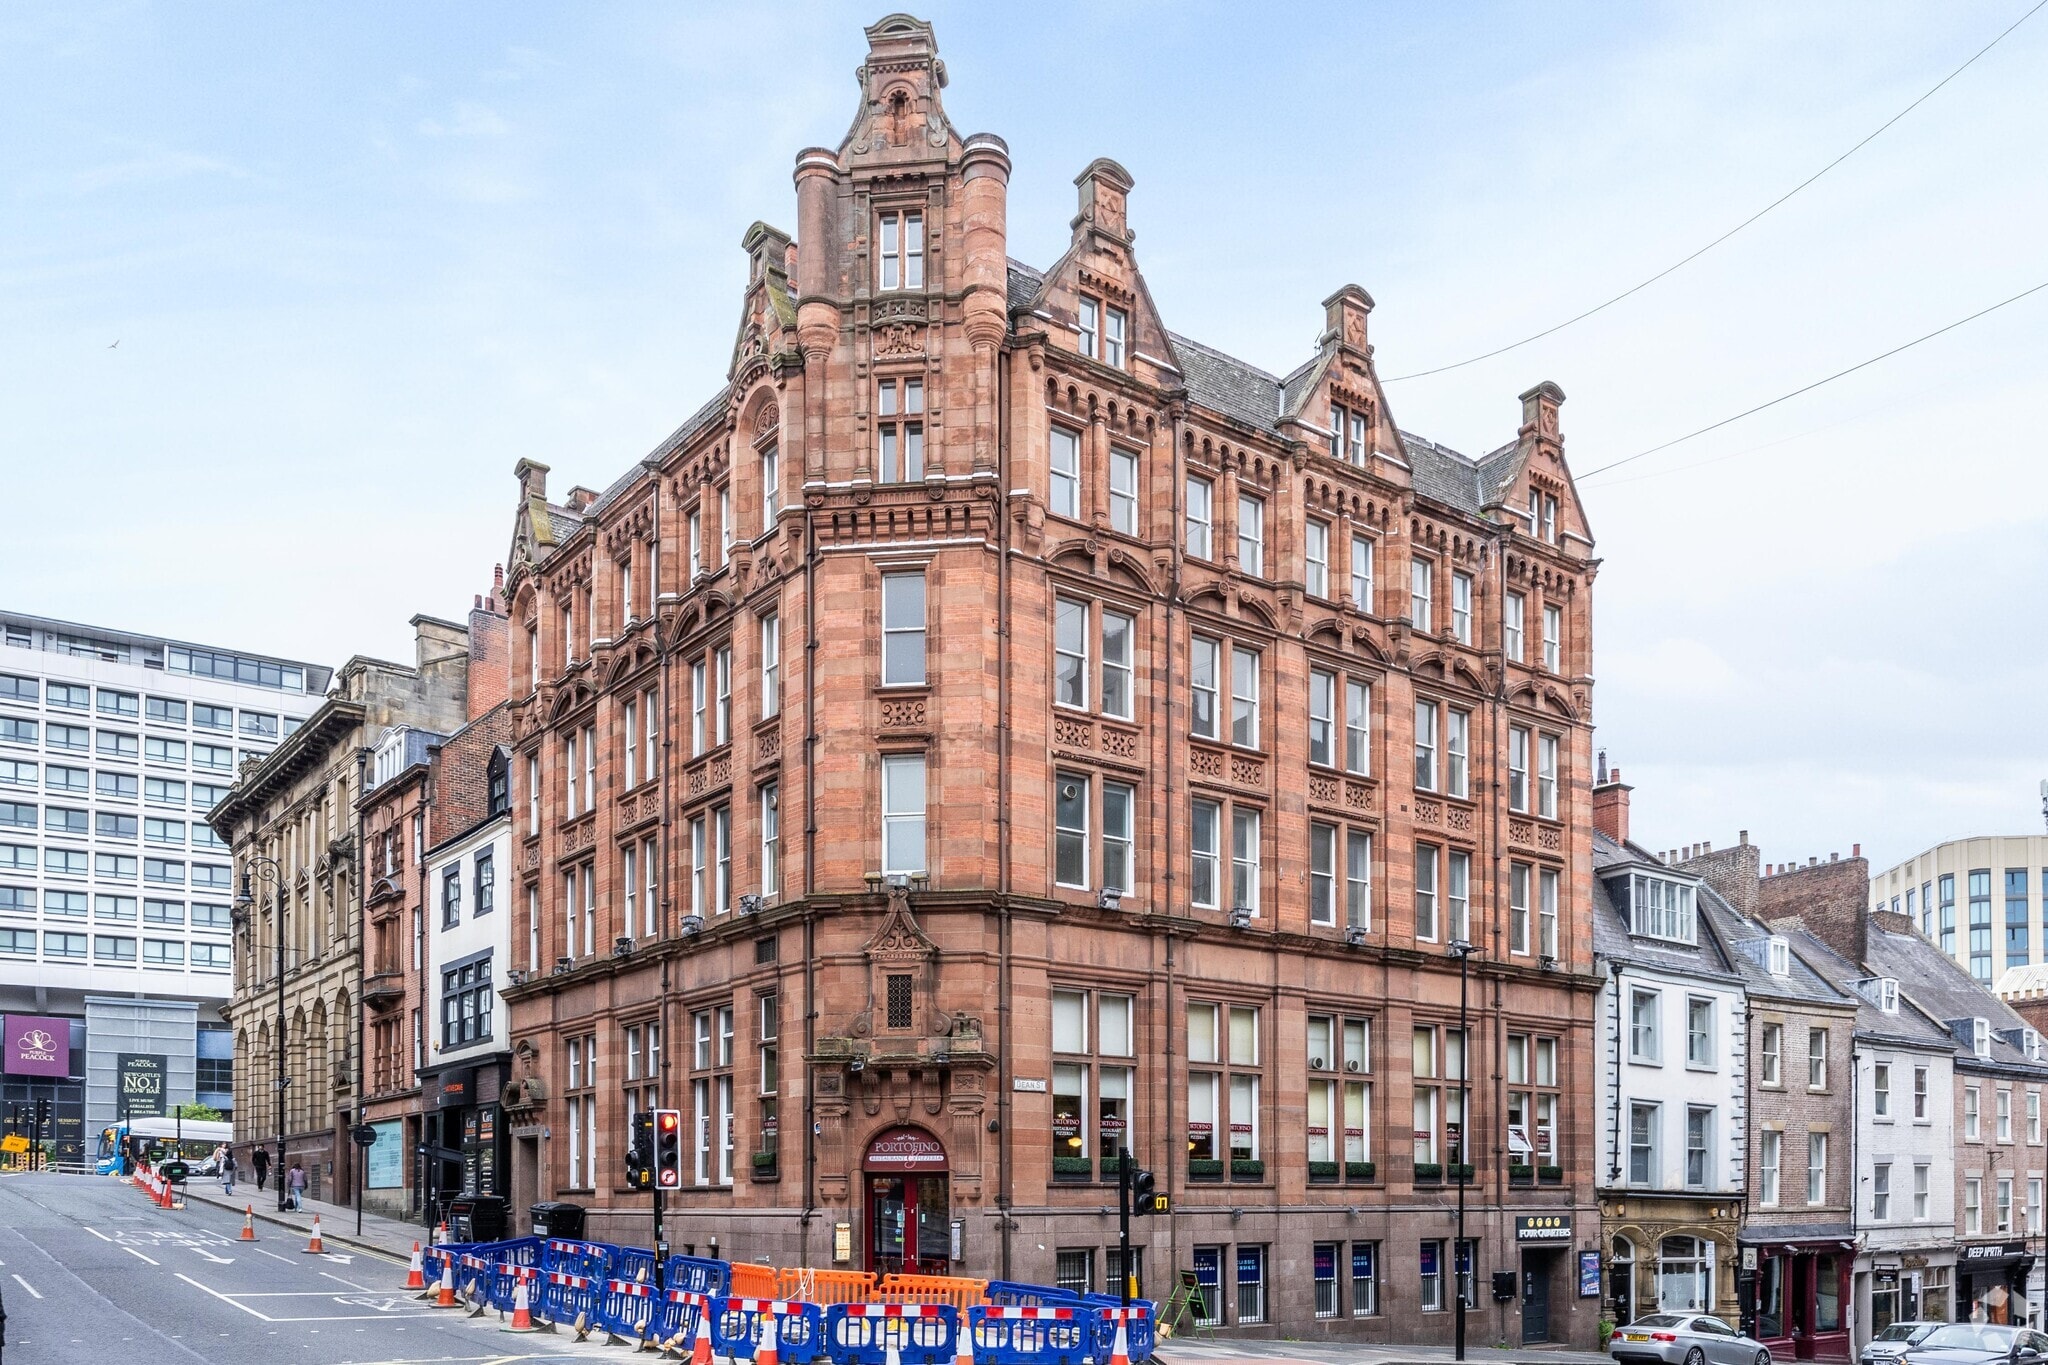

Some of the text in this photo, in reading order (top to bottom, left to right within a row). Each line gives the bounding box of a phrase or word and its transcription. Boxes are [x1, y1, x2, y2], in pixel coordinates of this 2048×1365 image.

[21, 1053, 55, 1061] PEACOCK
[124, 1076, 160, 1089] NO.1
[1016, 1080, 1035, 1088] DEAN
[875, 1141, 940, 1152] PORTOFINO
[1519, 1228, 1571, 1238] FOUR QUARTERS
[1968, 1247, 1984, 1258] DEEP
